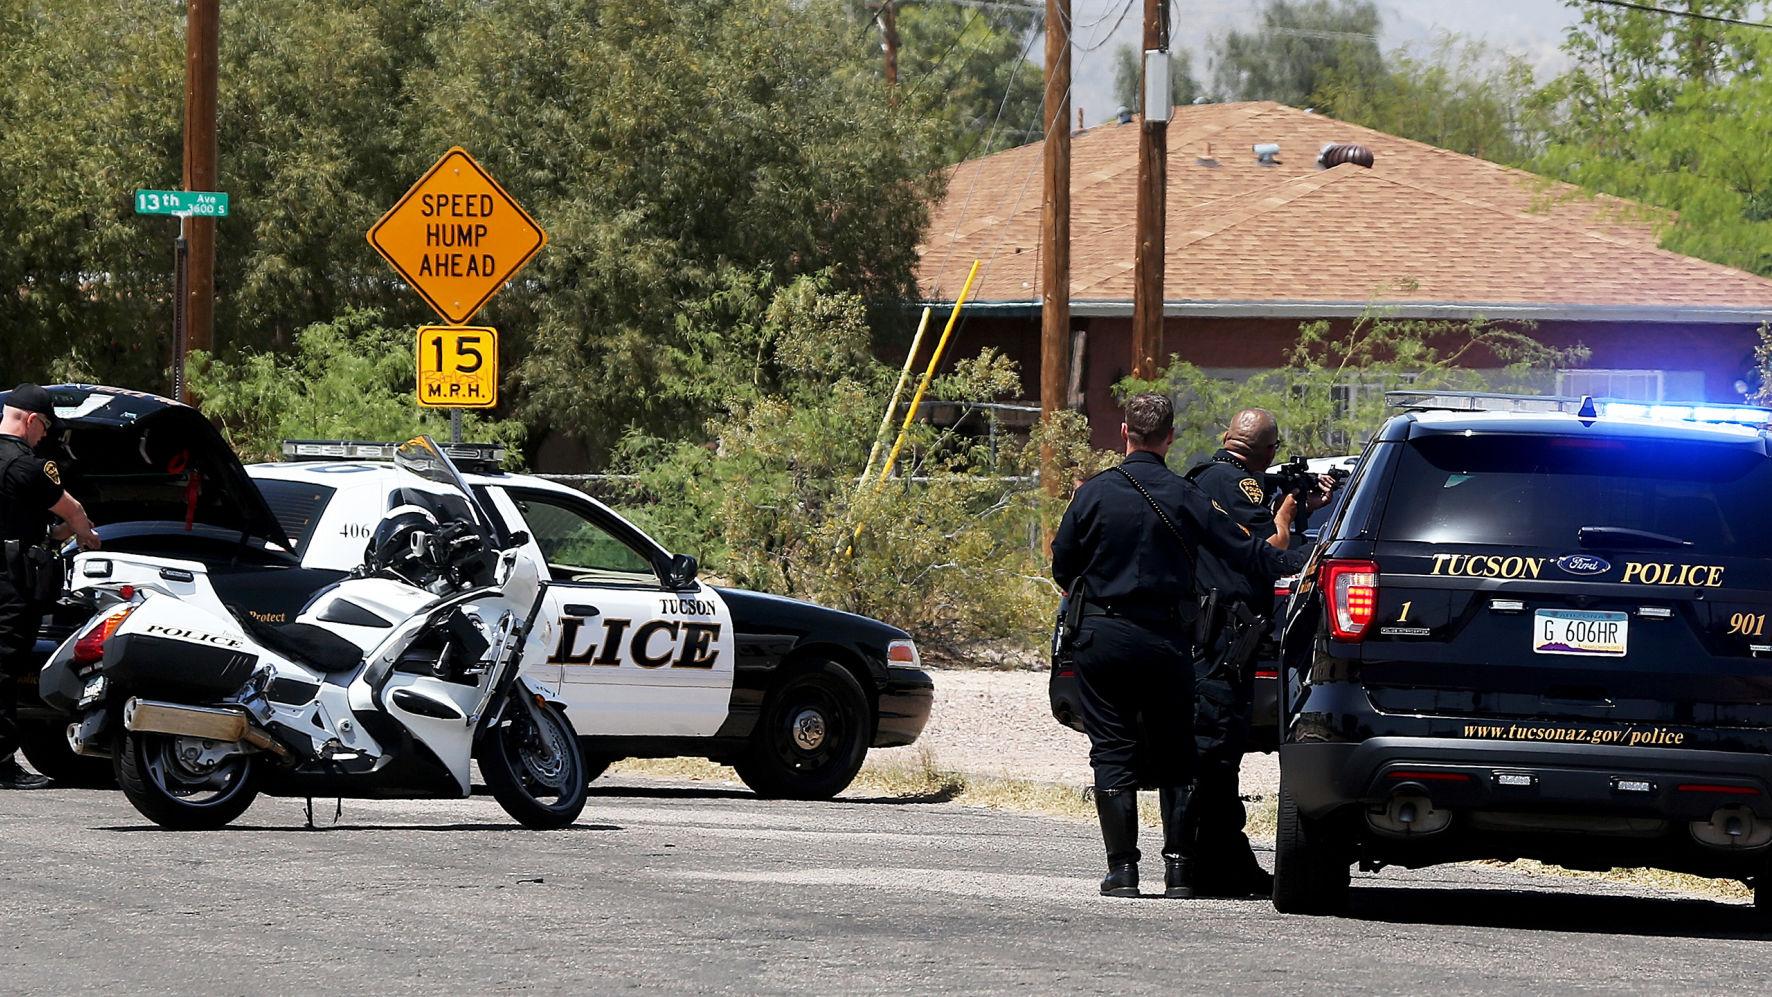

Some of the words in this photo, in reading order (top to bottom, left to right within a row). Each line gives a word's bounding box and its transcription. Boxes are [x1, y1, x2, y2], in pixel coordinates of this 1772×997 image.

[138, 193, 180, 210] 13th
[196, 193, 217, 203] Ave
[187, 203, 214, 214] 3600
[217, 204, 225, 214] S
[420, 193, 494, 218] SPEED
[426, 223, 488, 248] HUMP
[418, 253, 496, 278] AHEAD
[431, 335, 483, 374] 15
[427, 383, 486, 399] M.P.H.
[338, 522, 371, 539] 406
[1429, 553, 1547, 579] TUCSON
[1620, 561, 1725, 588] POLICE
[658, 598, 717, 616] TUCSON
[1396, 600, 1412, 622] 1
[1544, 619, 1554, 641] G
[1565, 620, 1618, 644] 606HR
[1726, 612, 1766, 636] 901
[146, 624, 244, 649] POLICE
[545, 615, 722, 670] LICE
[1463, 723, 1685, 746] www.tucsonaz.gov/police
